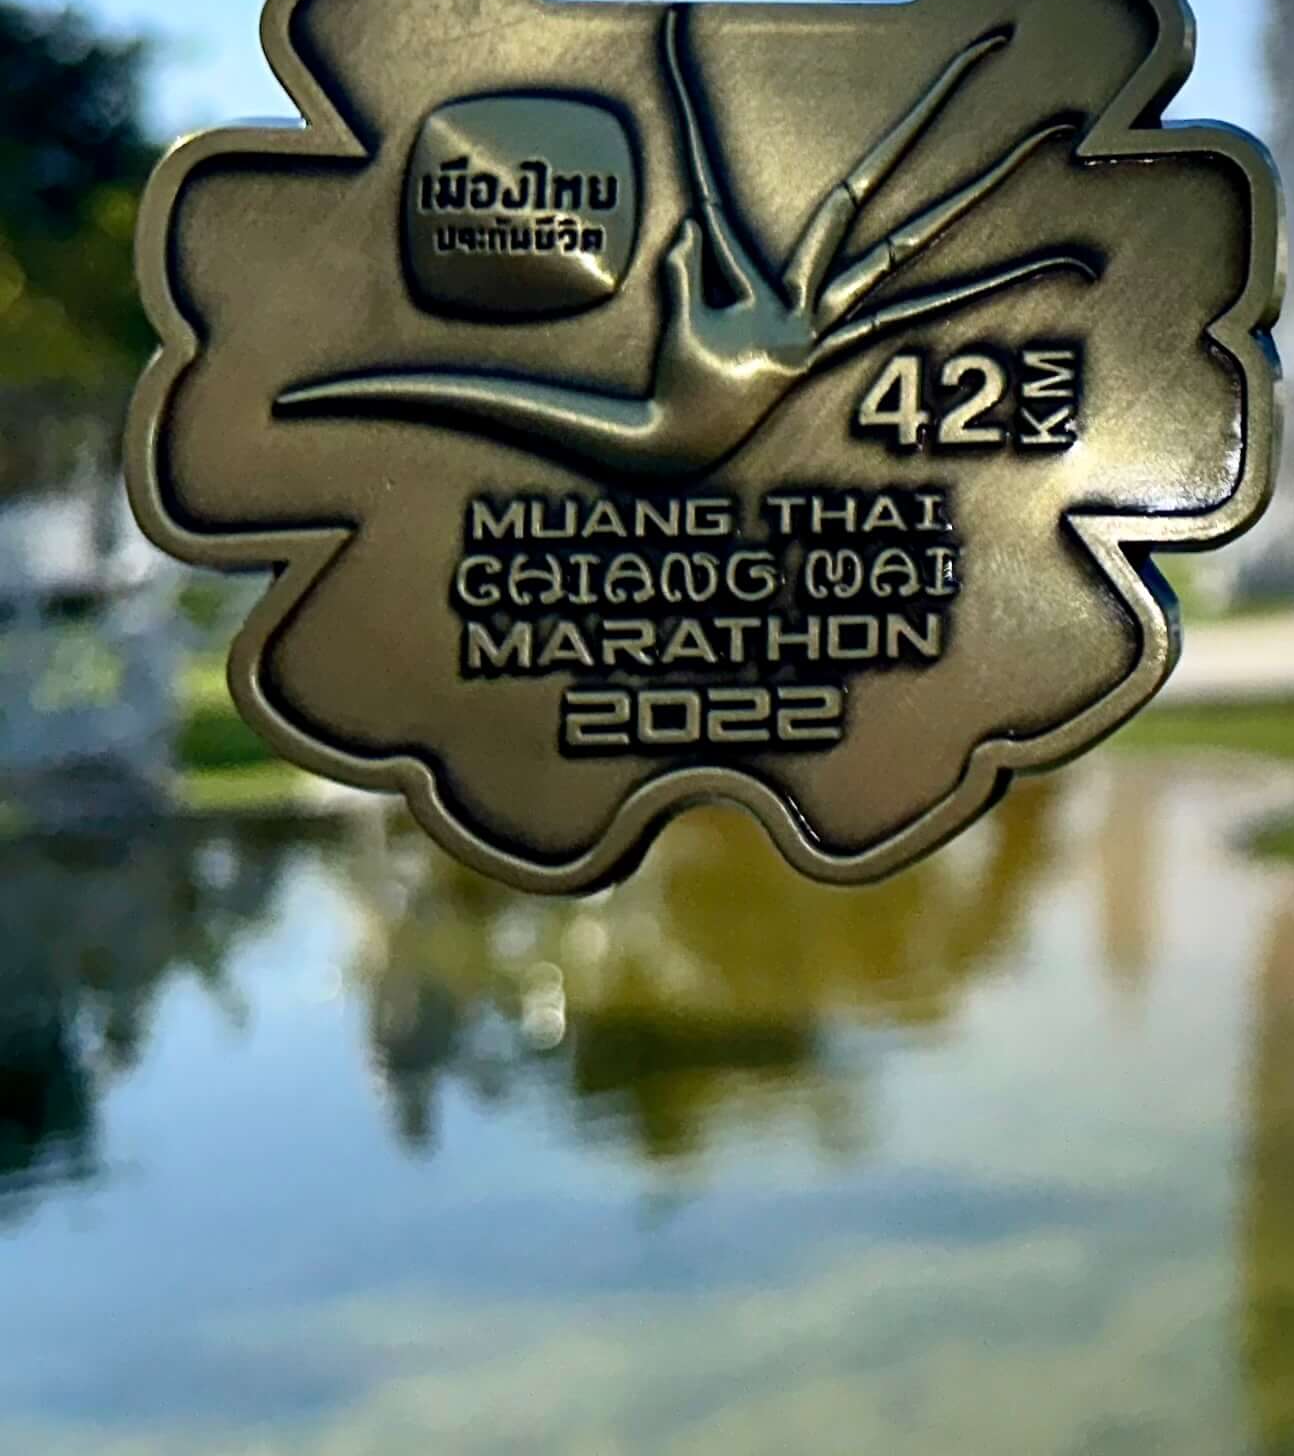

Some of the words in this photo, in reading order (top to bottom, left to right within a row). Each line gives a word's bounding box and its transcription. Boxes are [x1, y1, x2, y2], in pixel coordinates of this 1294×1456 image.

[419, 155, 618, 211] เมืองไทย
[858, 354, 1006, 445] 42
[1021, 350, 1076, 444] KM
[471, 497, 732, 540] MUANG
[768, 494, 952, 533] THAI
[457, 550, 778, 606] CHIANG
[804, 546, 960, 598] MAI
[467, 614, 942, 669] MARATHON
[564, 685, 846, 745] 2022
